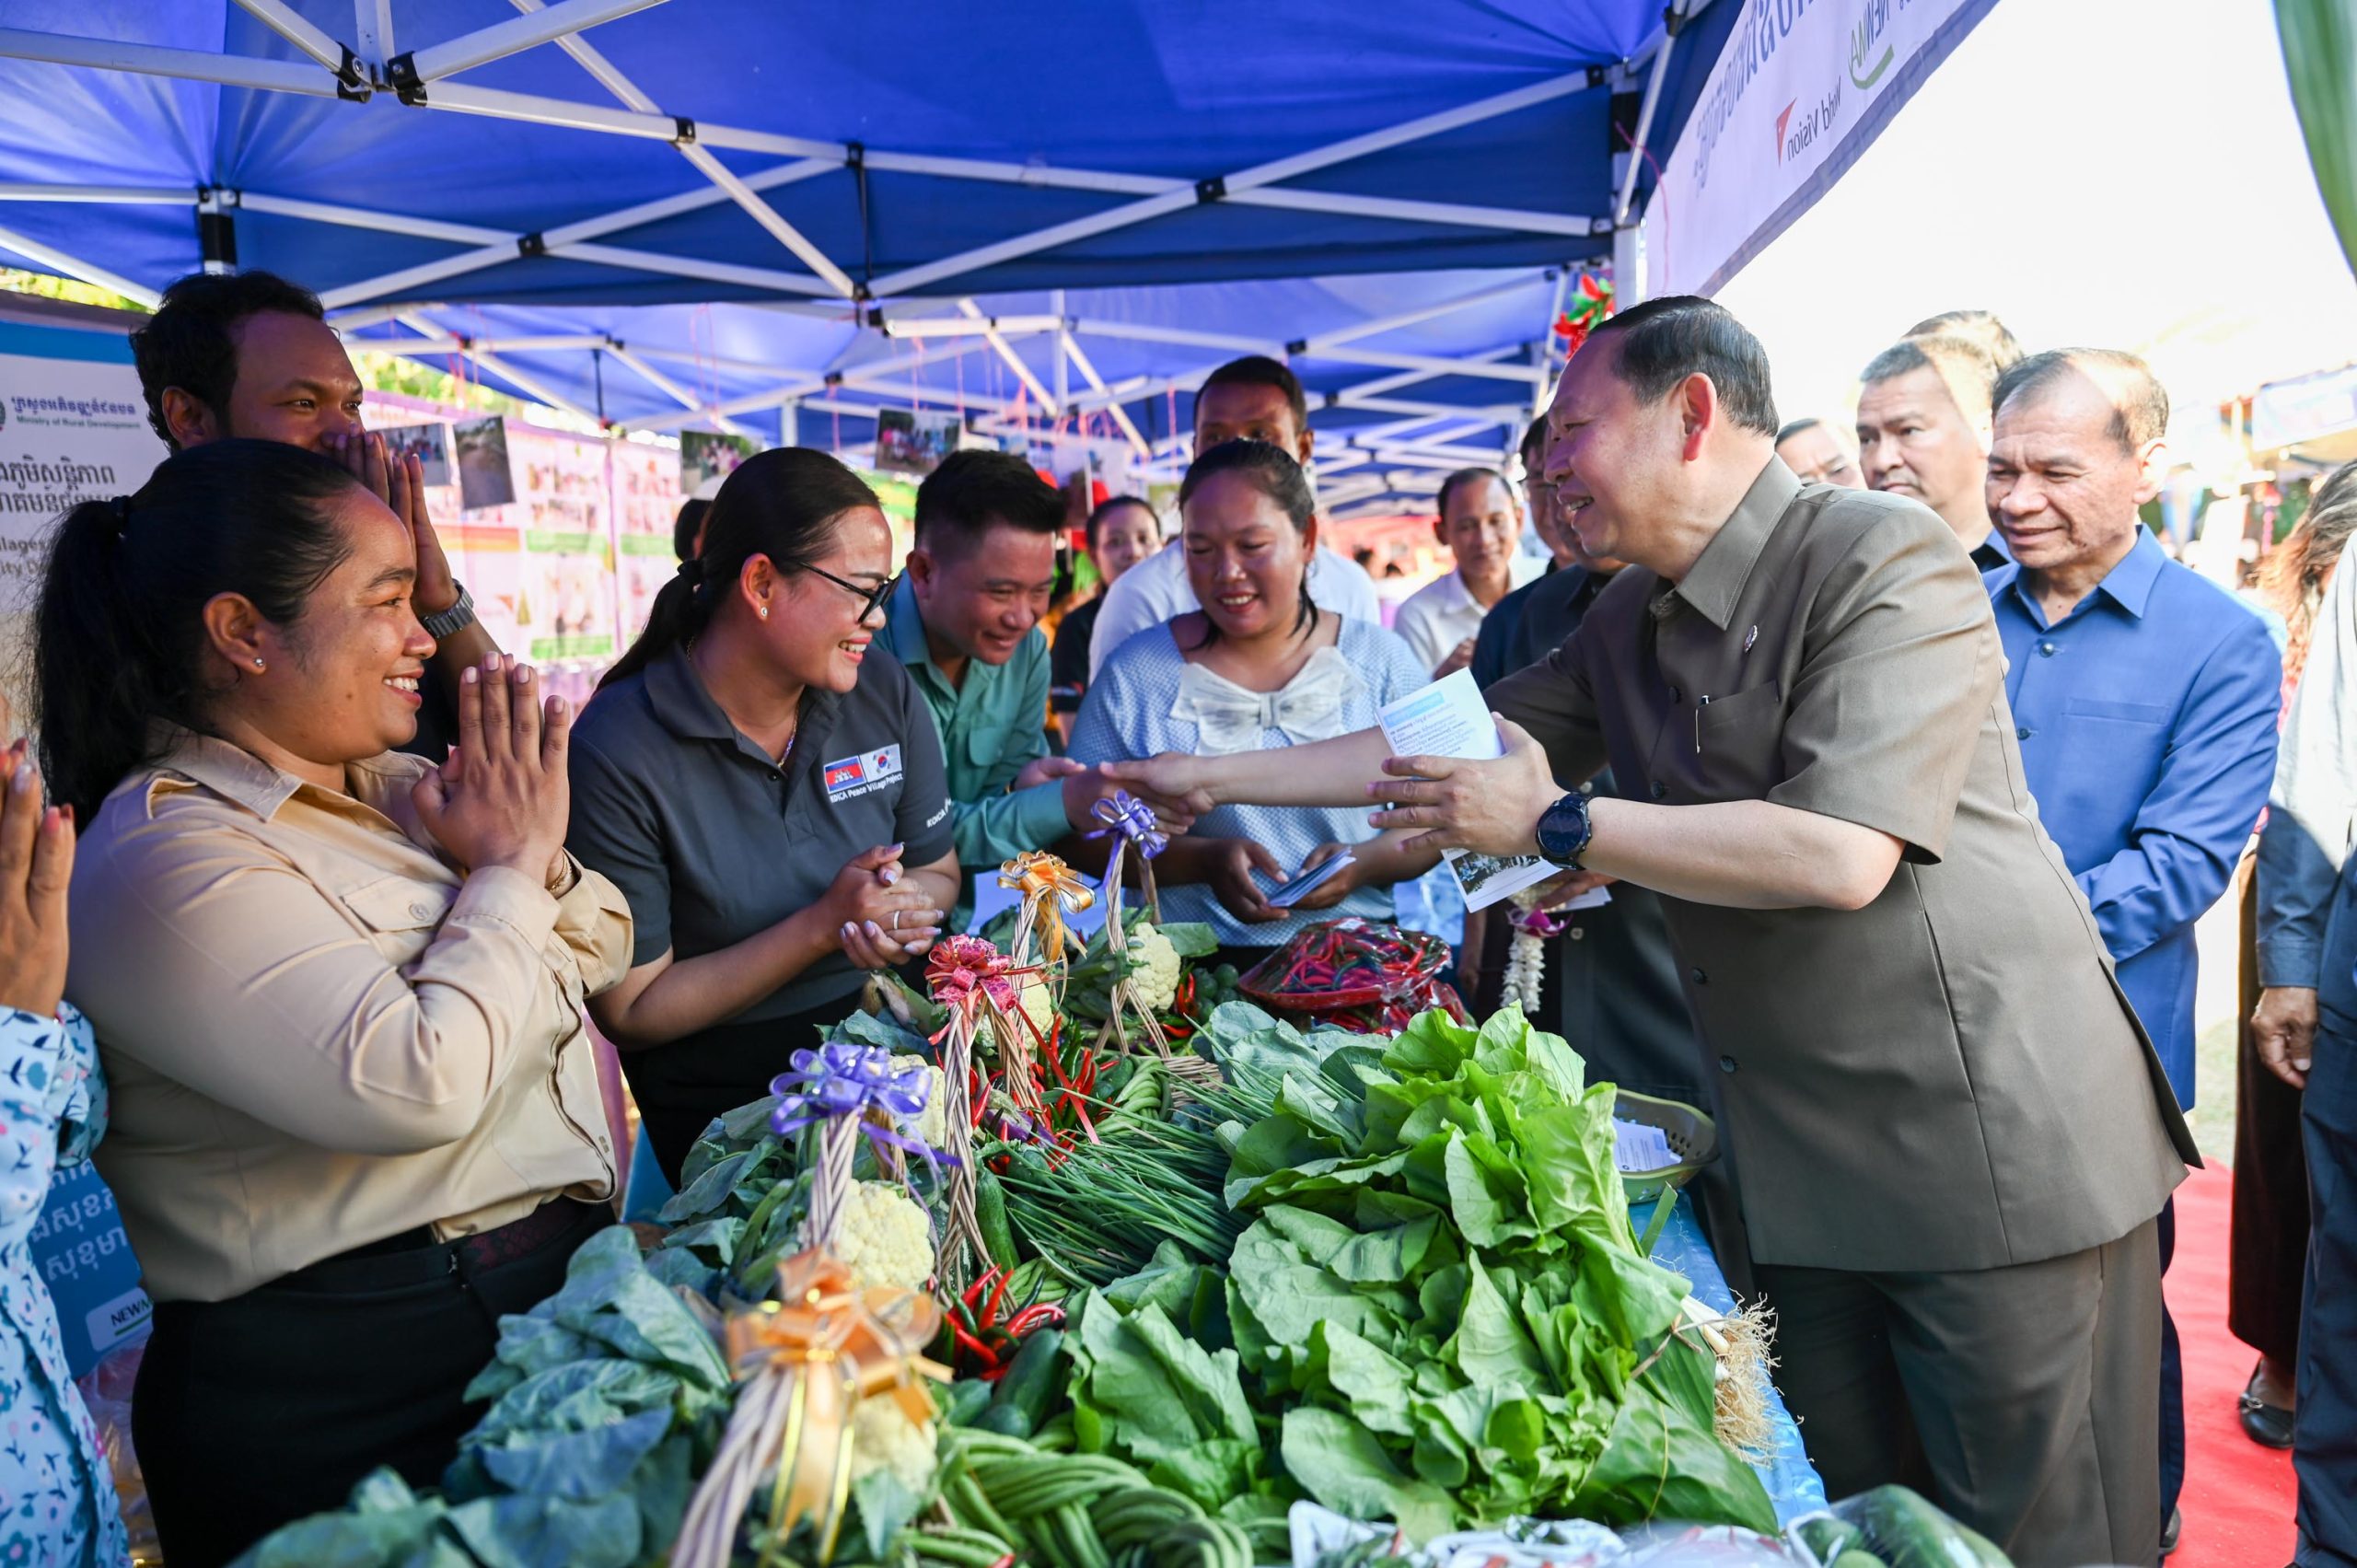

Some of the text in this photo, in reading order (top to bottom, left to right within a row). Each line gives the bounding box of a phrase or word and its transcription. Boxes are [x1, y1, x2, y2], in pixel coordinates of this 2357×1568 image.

[17, 414, 50, 426] Ministry
[63, 418, 85, 427] Rural
[87, 420, 140, 429] Development
[830, 772, 903, 803] KOICA Peace Village Project
